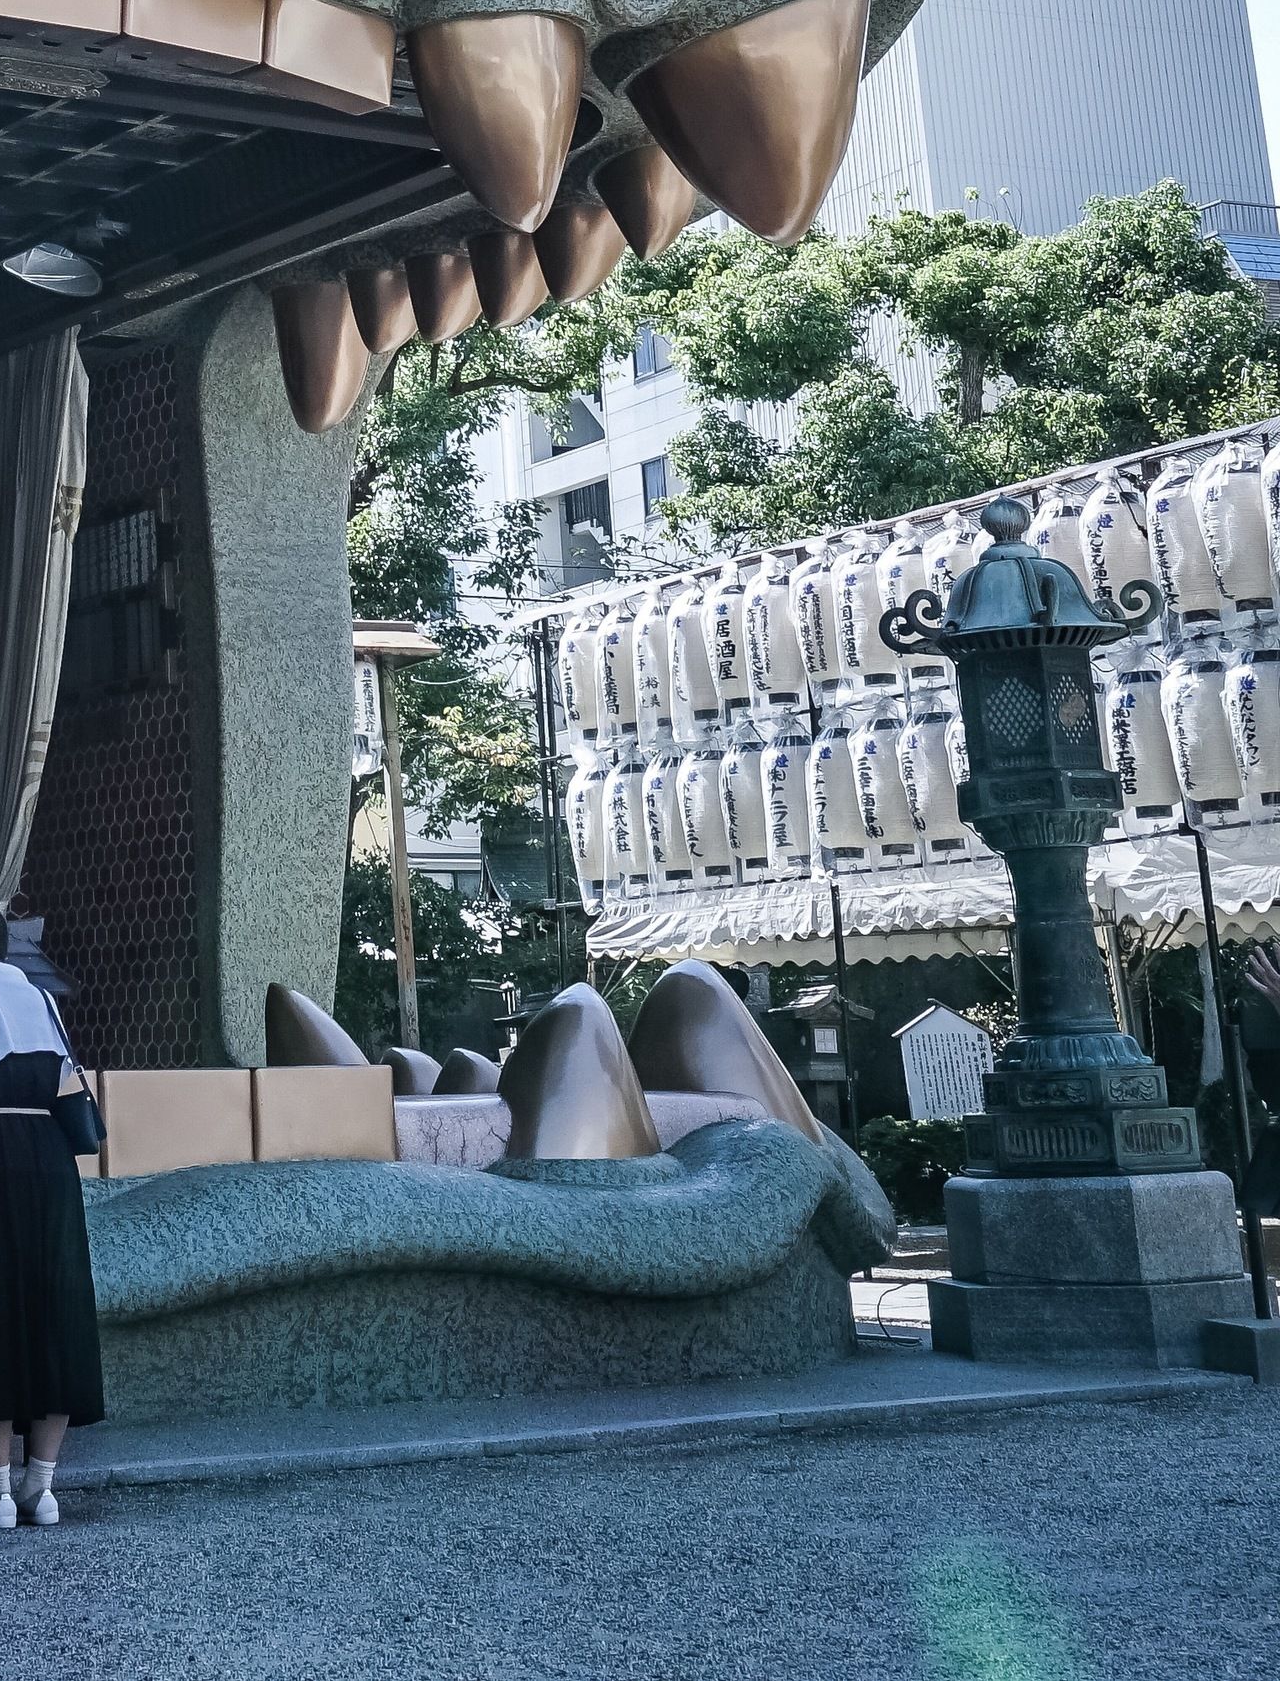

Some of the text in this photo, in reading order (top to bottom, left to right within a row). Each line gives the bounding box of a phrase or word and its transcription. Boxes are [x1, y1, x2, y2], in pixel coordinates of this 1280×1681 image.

[715, 619, 738, 680] 居酒屋
[611, 797, 632, 853] 株式会社
